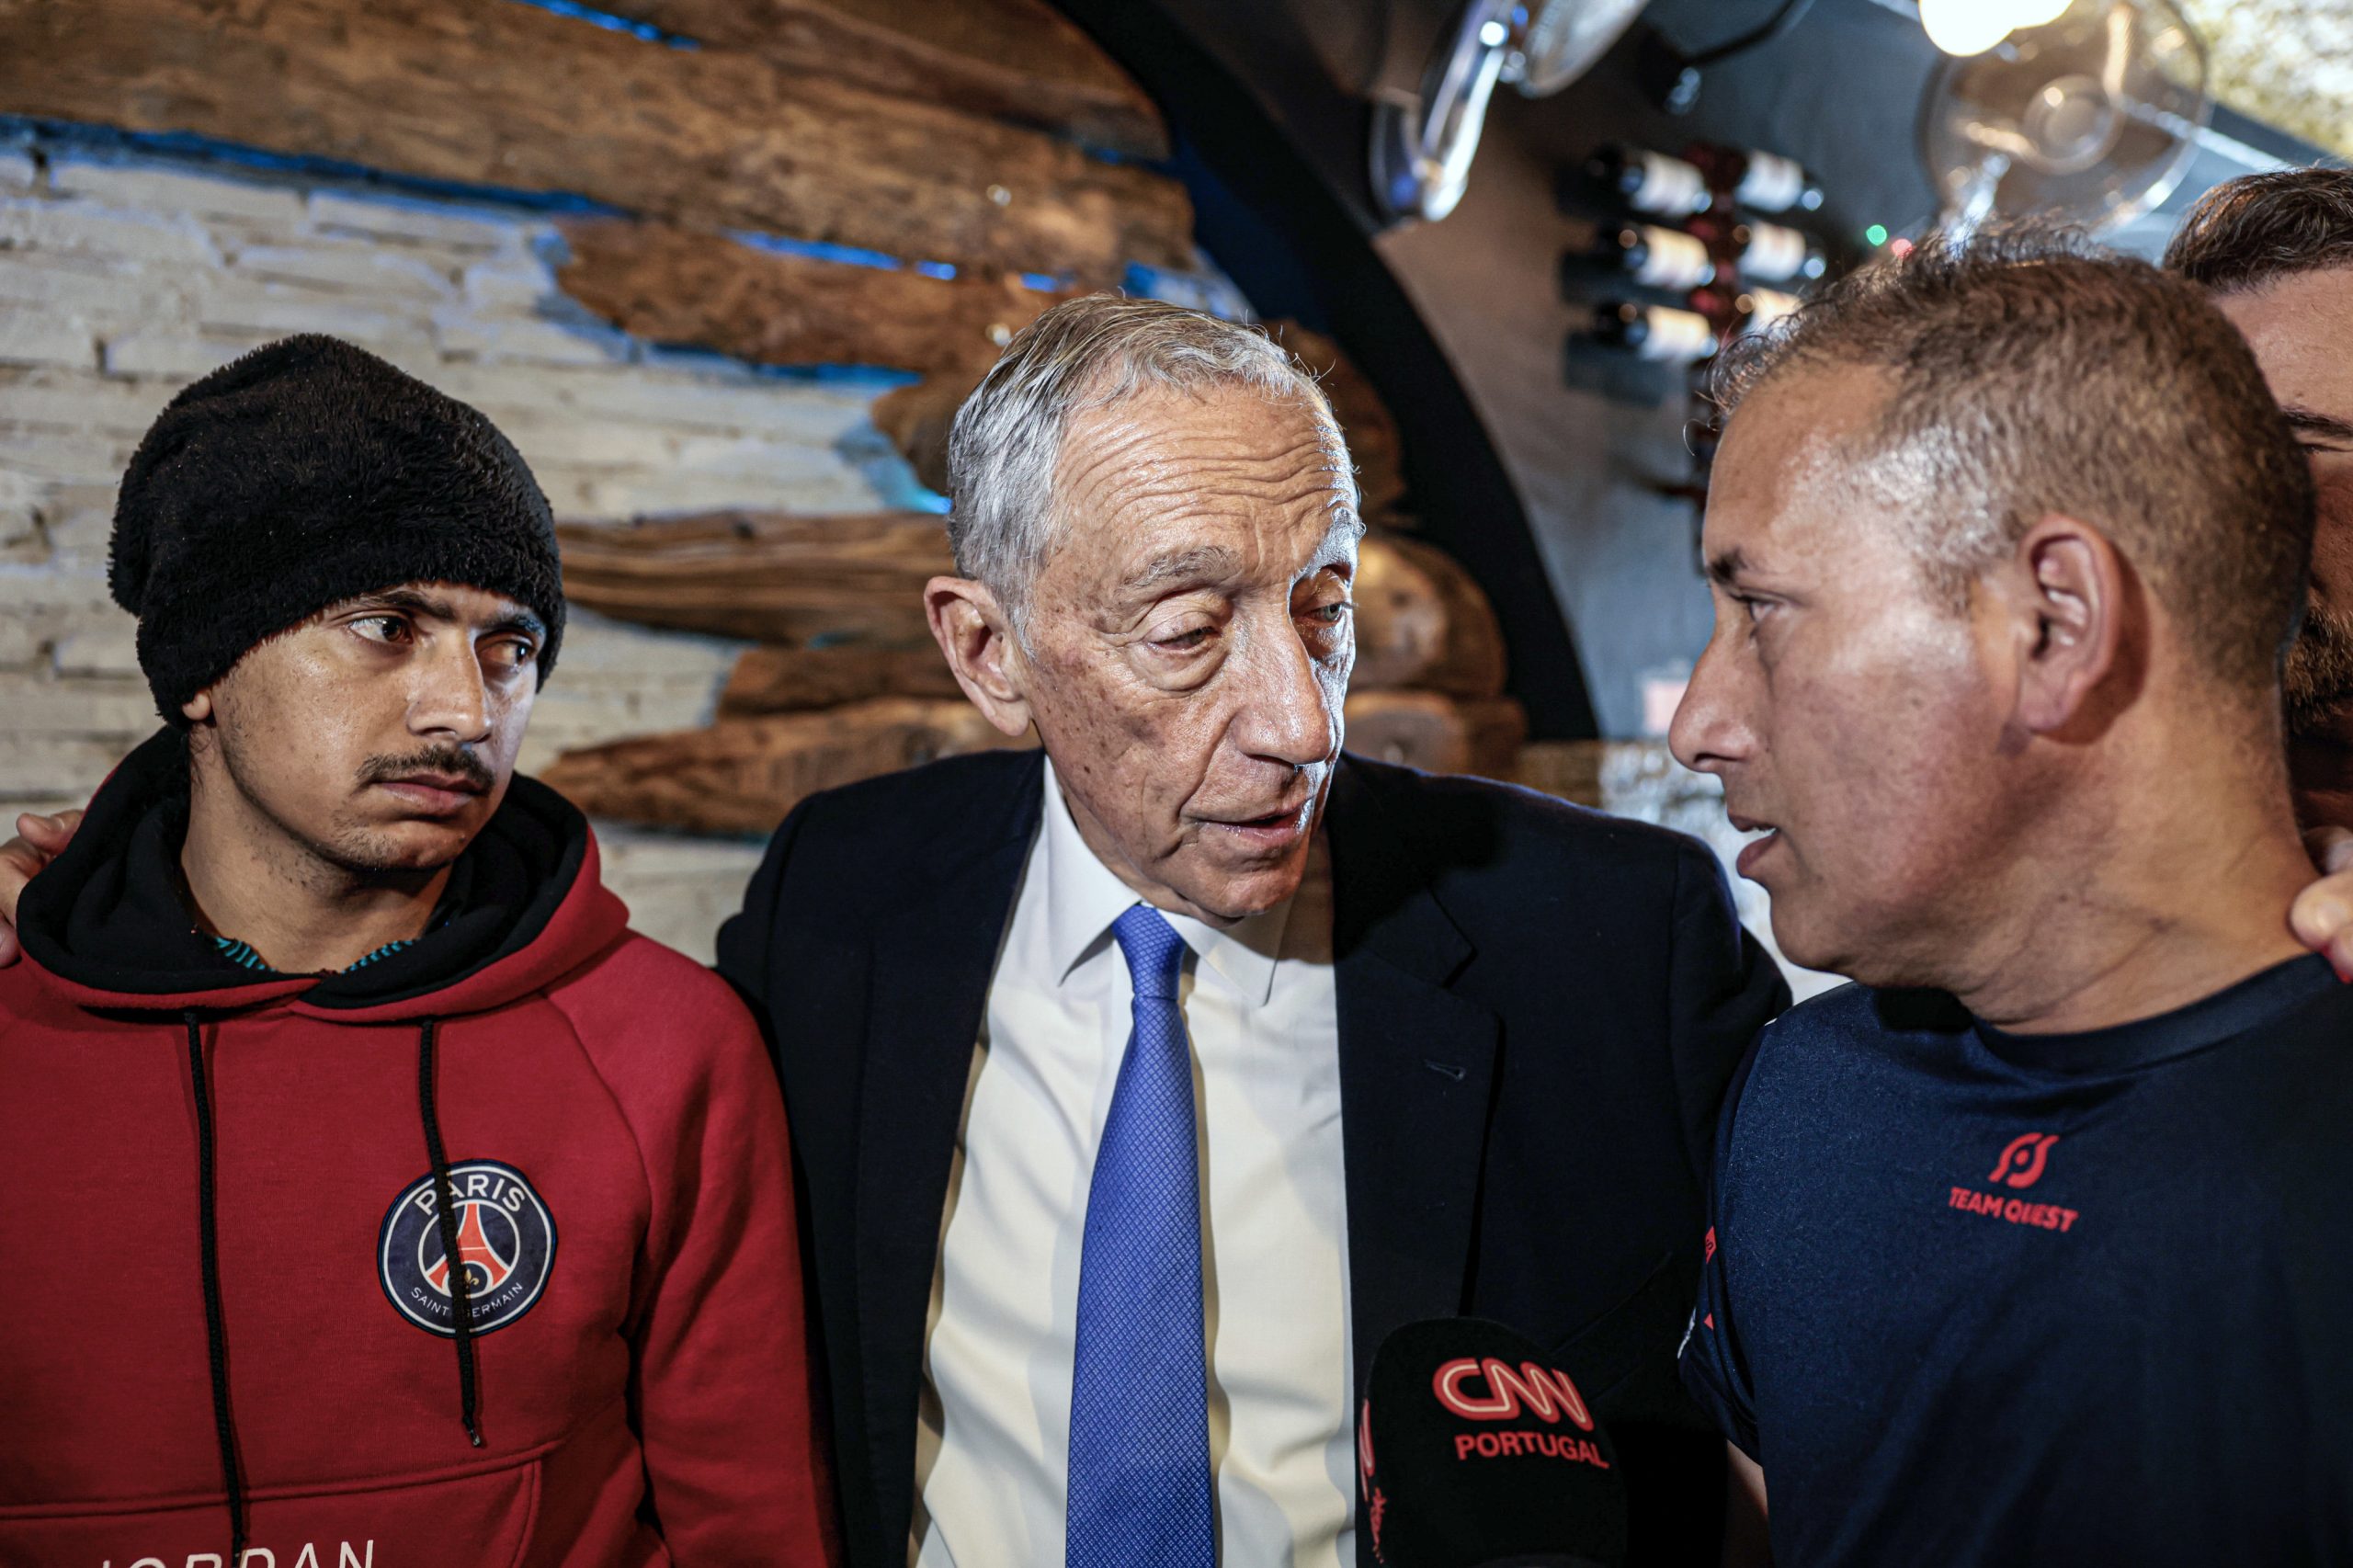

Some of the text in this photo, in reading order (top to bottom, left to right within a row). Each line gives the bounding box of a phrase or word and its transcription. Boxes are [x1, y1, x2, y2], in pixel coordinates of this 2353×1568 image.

[415, 1174, 526, 1216] PARIS
[1949, 1187, 2005, 1219] TEAM
[411, 1282, 524, 1318] SAINT ERMAIN
[1433, 1358, 1595, 1432] CNN
[1454, 1431, 1610, 1469] PORTUGAL
[102, 1539, 375, 1568] DAN
